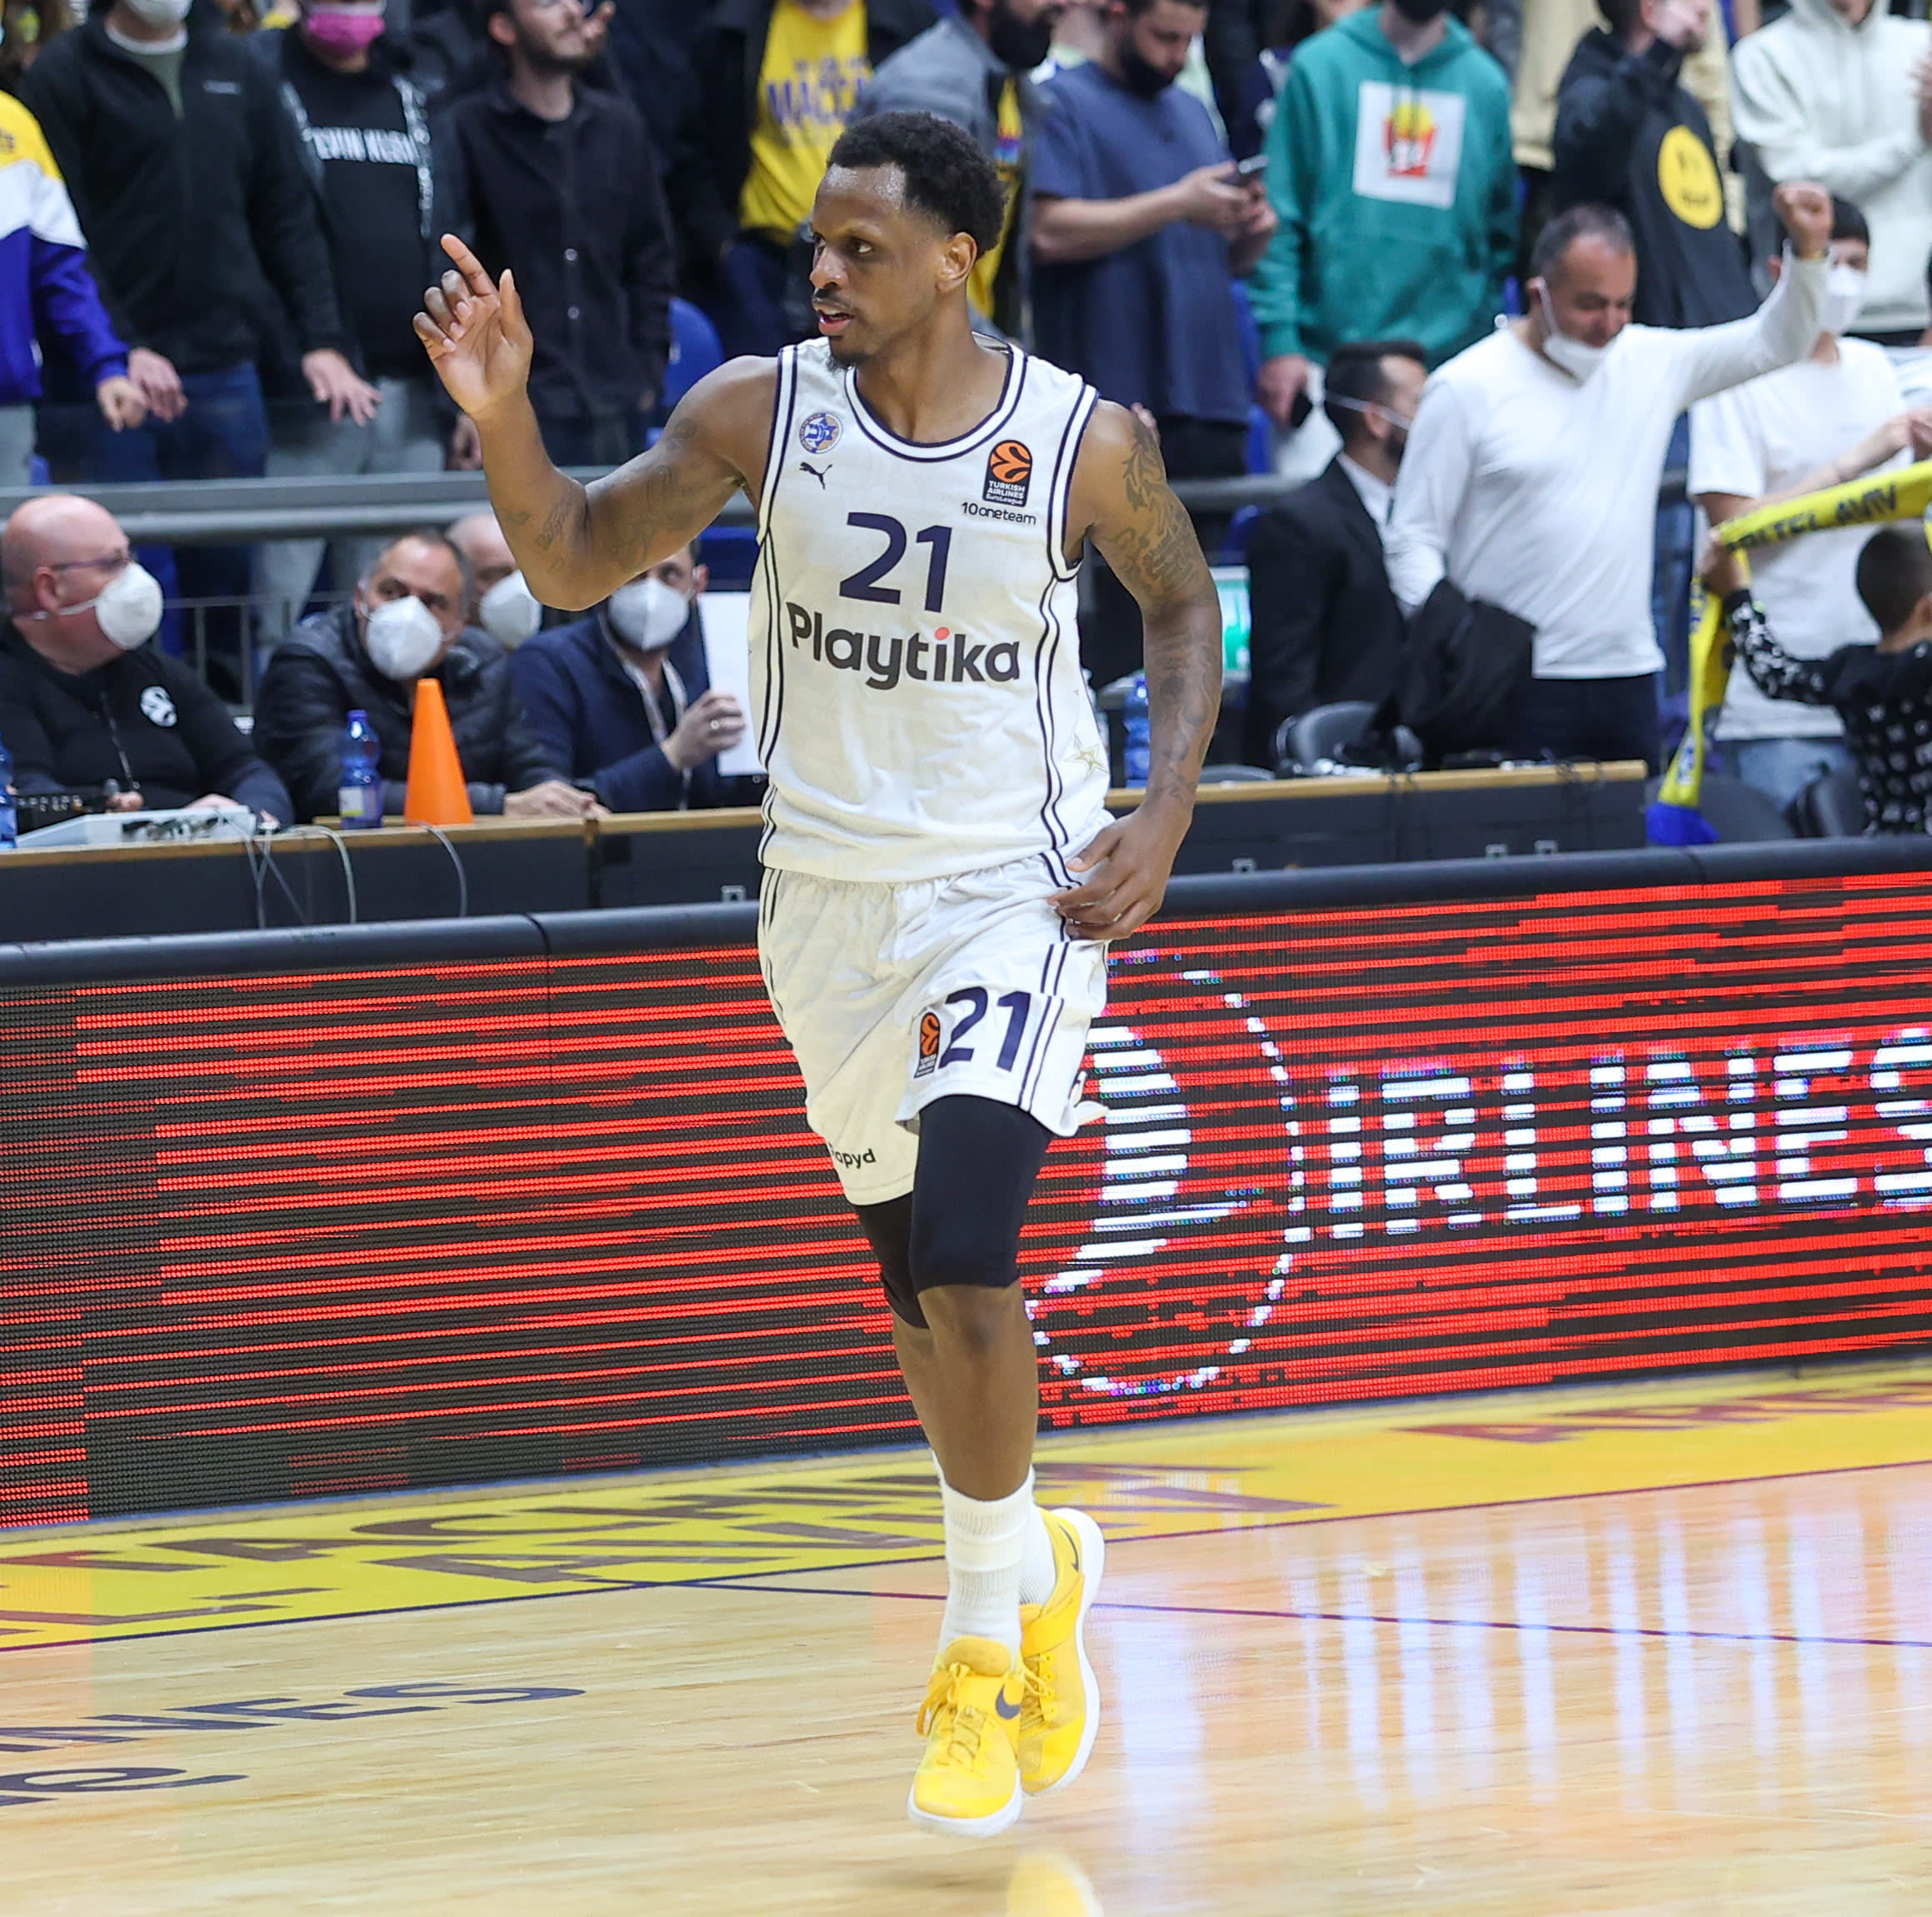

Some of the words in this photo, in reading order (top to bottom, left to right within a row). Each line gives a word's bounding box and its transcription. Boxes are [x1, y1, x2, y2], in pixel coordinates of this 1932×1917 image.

[987, 487, 1025, 499] AIRLINES
[989, 481, 1026, 492] TURKISH
[839, 512, 952, 613] 21
[786, 602, 1021, 690] Playtika
[937, 986, 1032, 1072] 21
[828, 1142, 876, 1169] apyd
